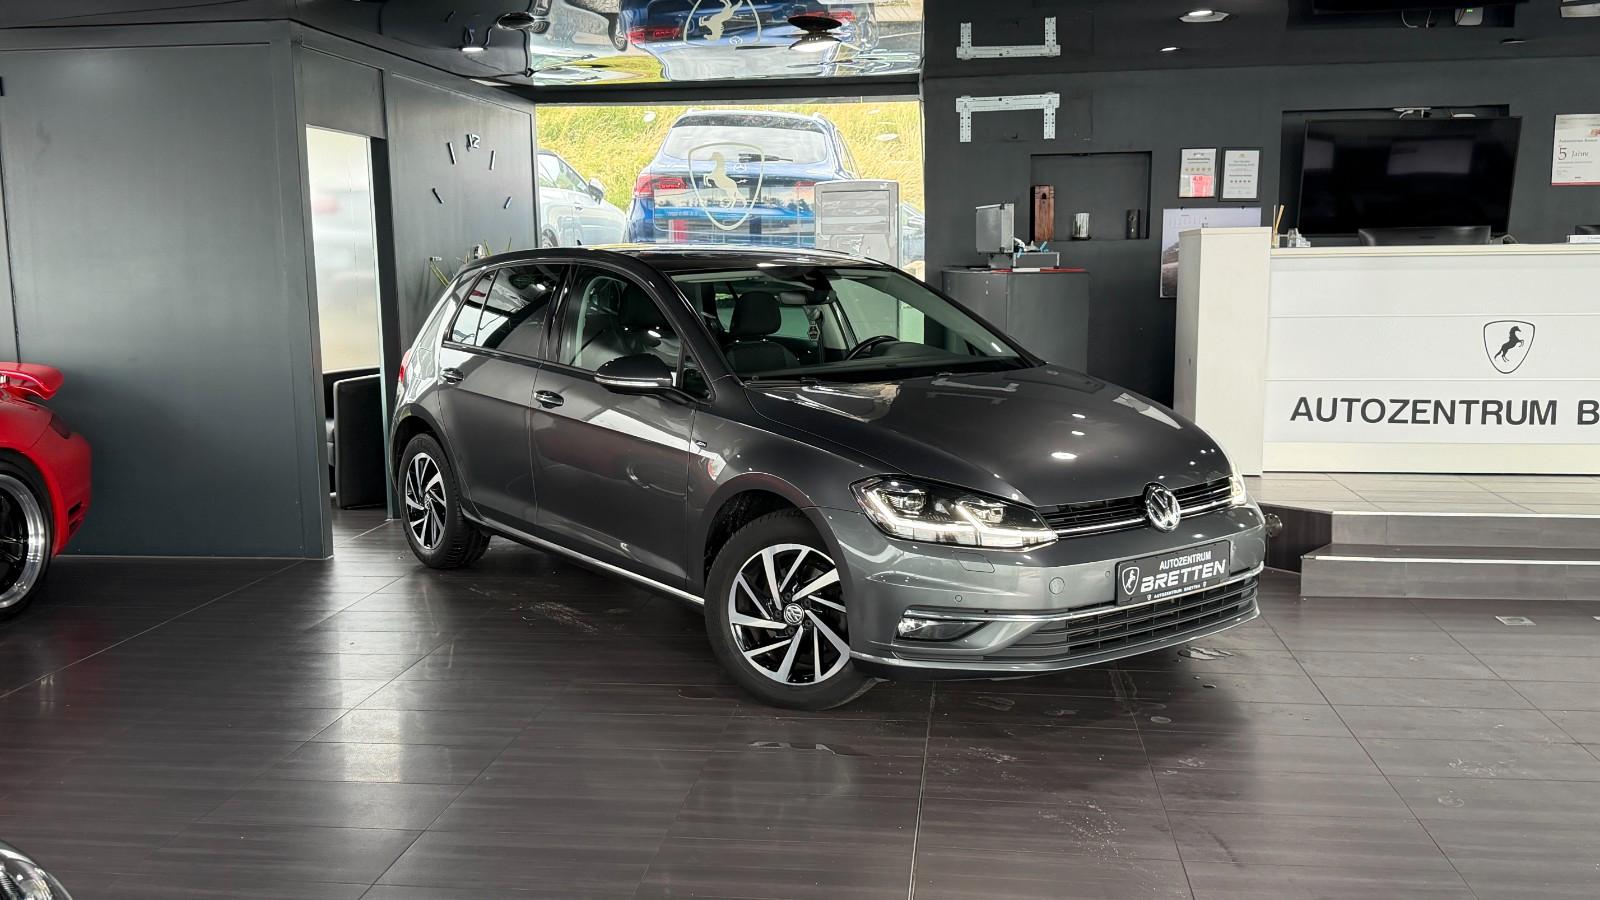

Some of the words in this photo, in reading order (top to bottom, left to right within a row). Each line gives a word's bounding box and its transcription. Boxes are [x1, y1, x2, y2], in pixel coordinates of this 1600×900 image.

[466, 133, 481, 149] 12
[1558, 147, 1567, 160] 5
[1290, 396, 1557, 425] AUTOZENTRUM
[1159, 551, 1212, 571] AUTOZENTRUM
[1140, 559, 1226, 592] BRETTEN
